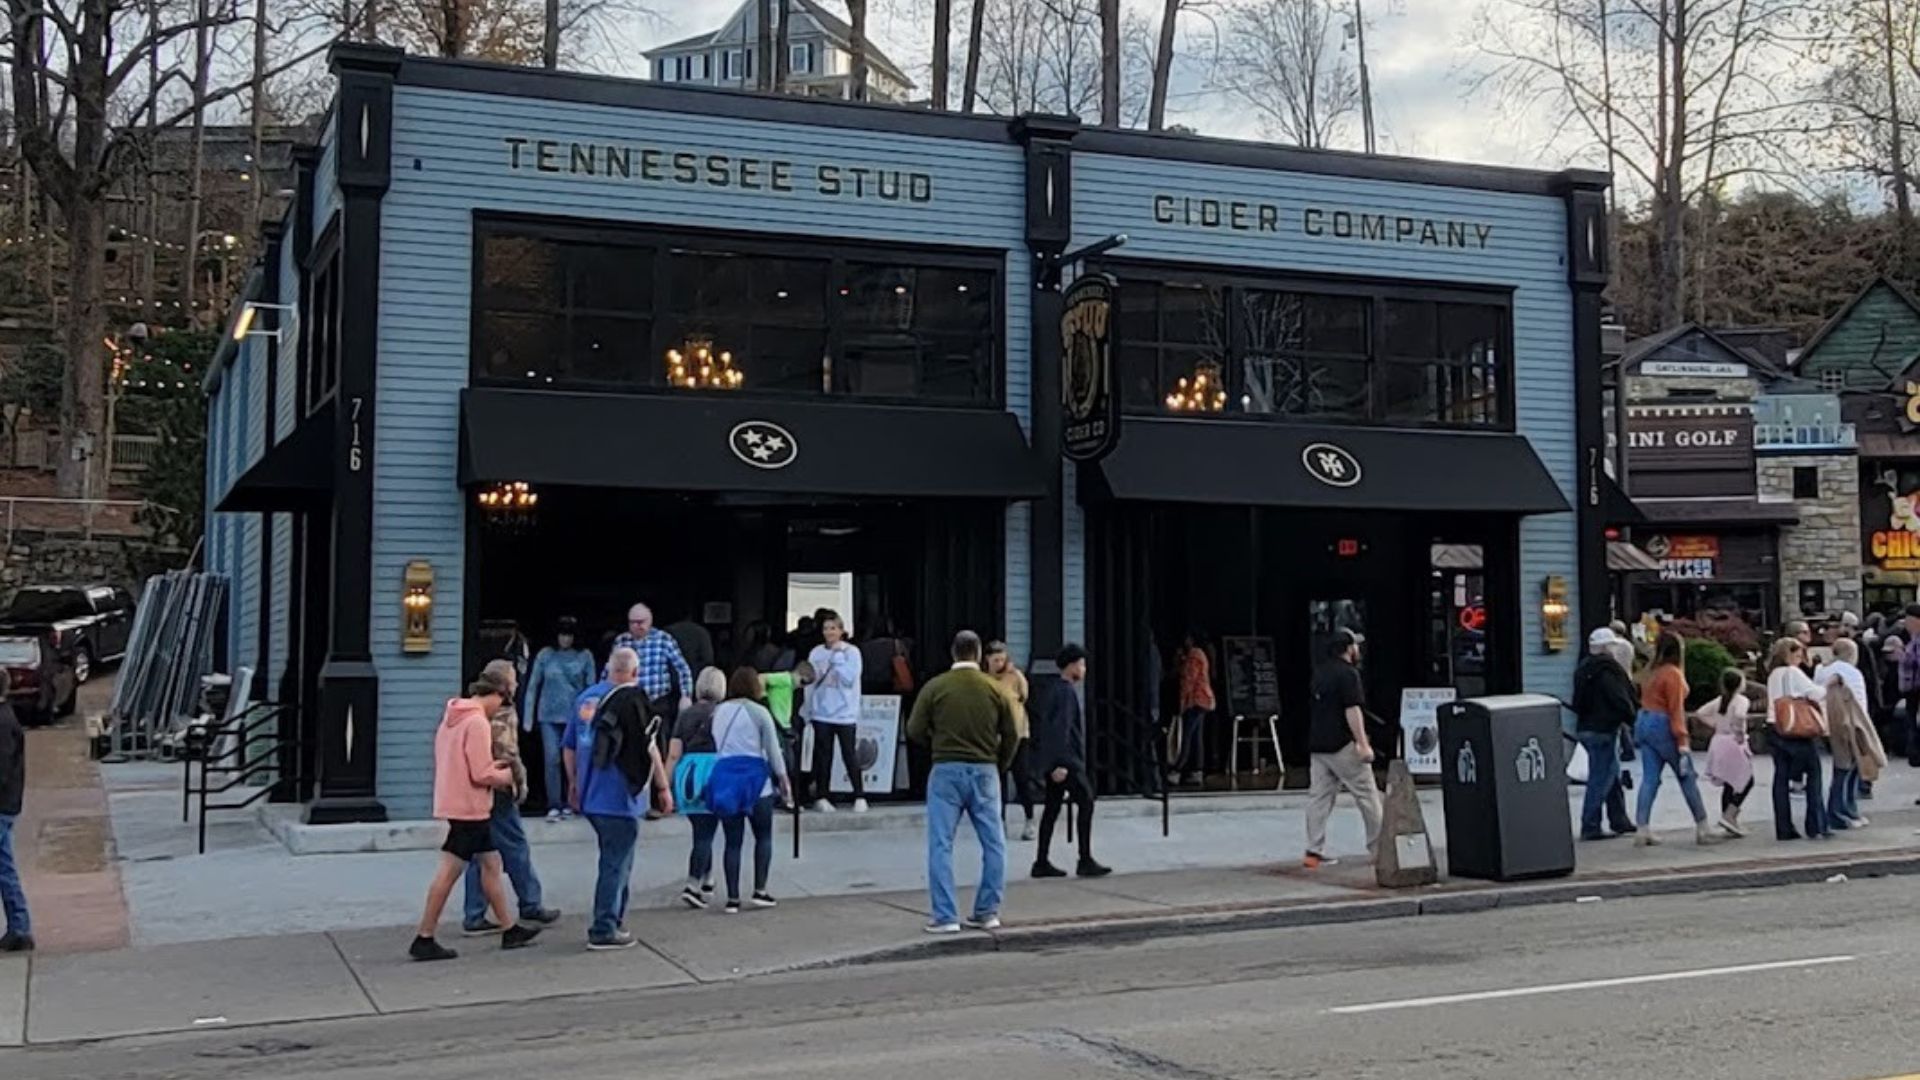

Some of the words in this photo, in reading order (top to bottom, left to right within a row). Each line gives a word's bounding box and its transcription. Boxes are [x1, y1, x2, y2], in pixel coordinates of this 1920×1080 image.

[505, 136, 792, 192] TENNESSEE
[818, 165, 933, 203] STUD
[1154, 195, 1279, 232] CIDER
[1305, 208, 1493, 250] COMPANY
[349, 397, 362, 471] 716
[1675, 430, 1738, 447] GOLF
[1659, 569, 1714, 580] PALACE
